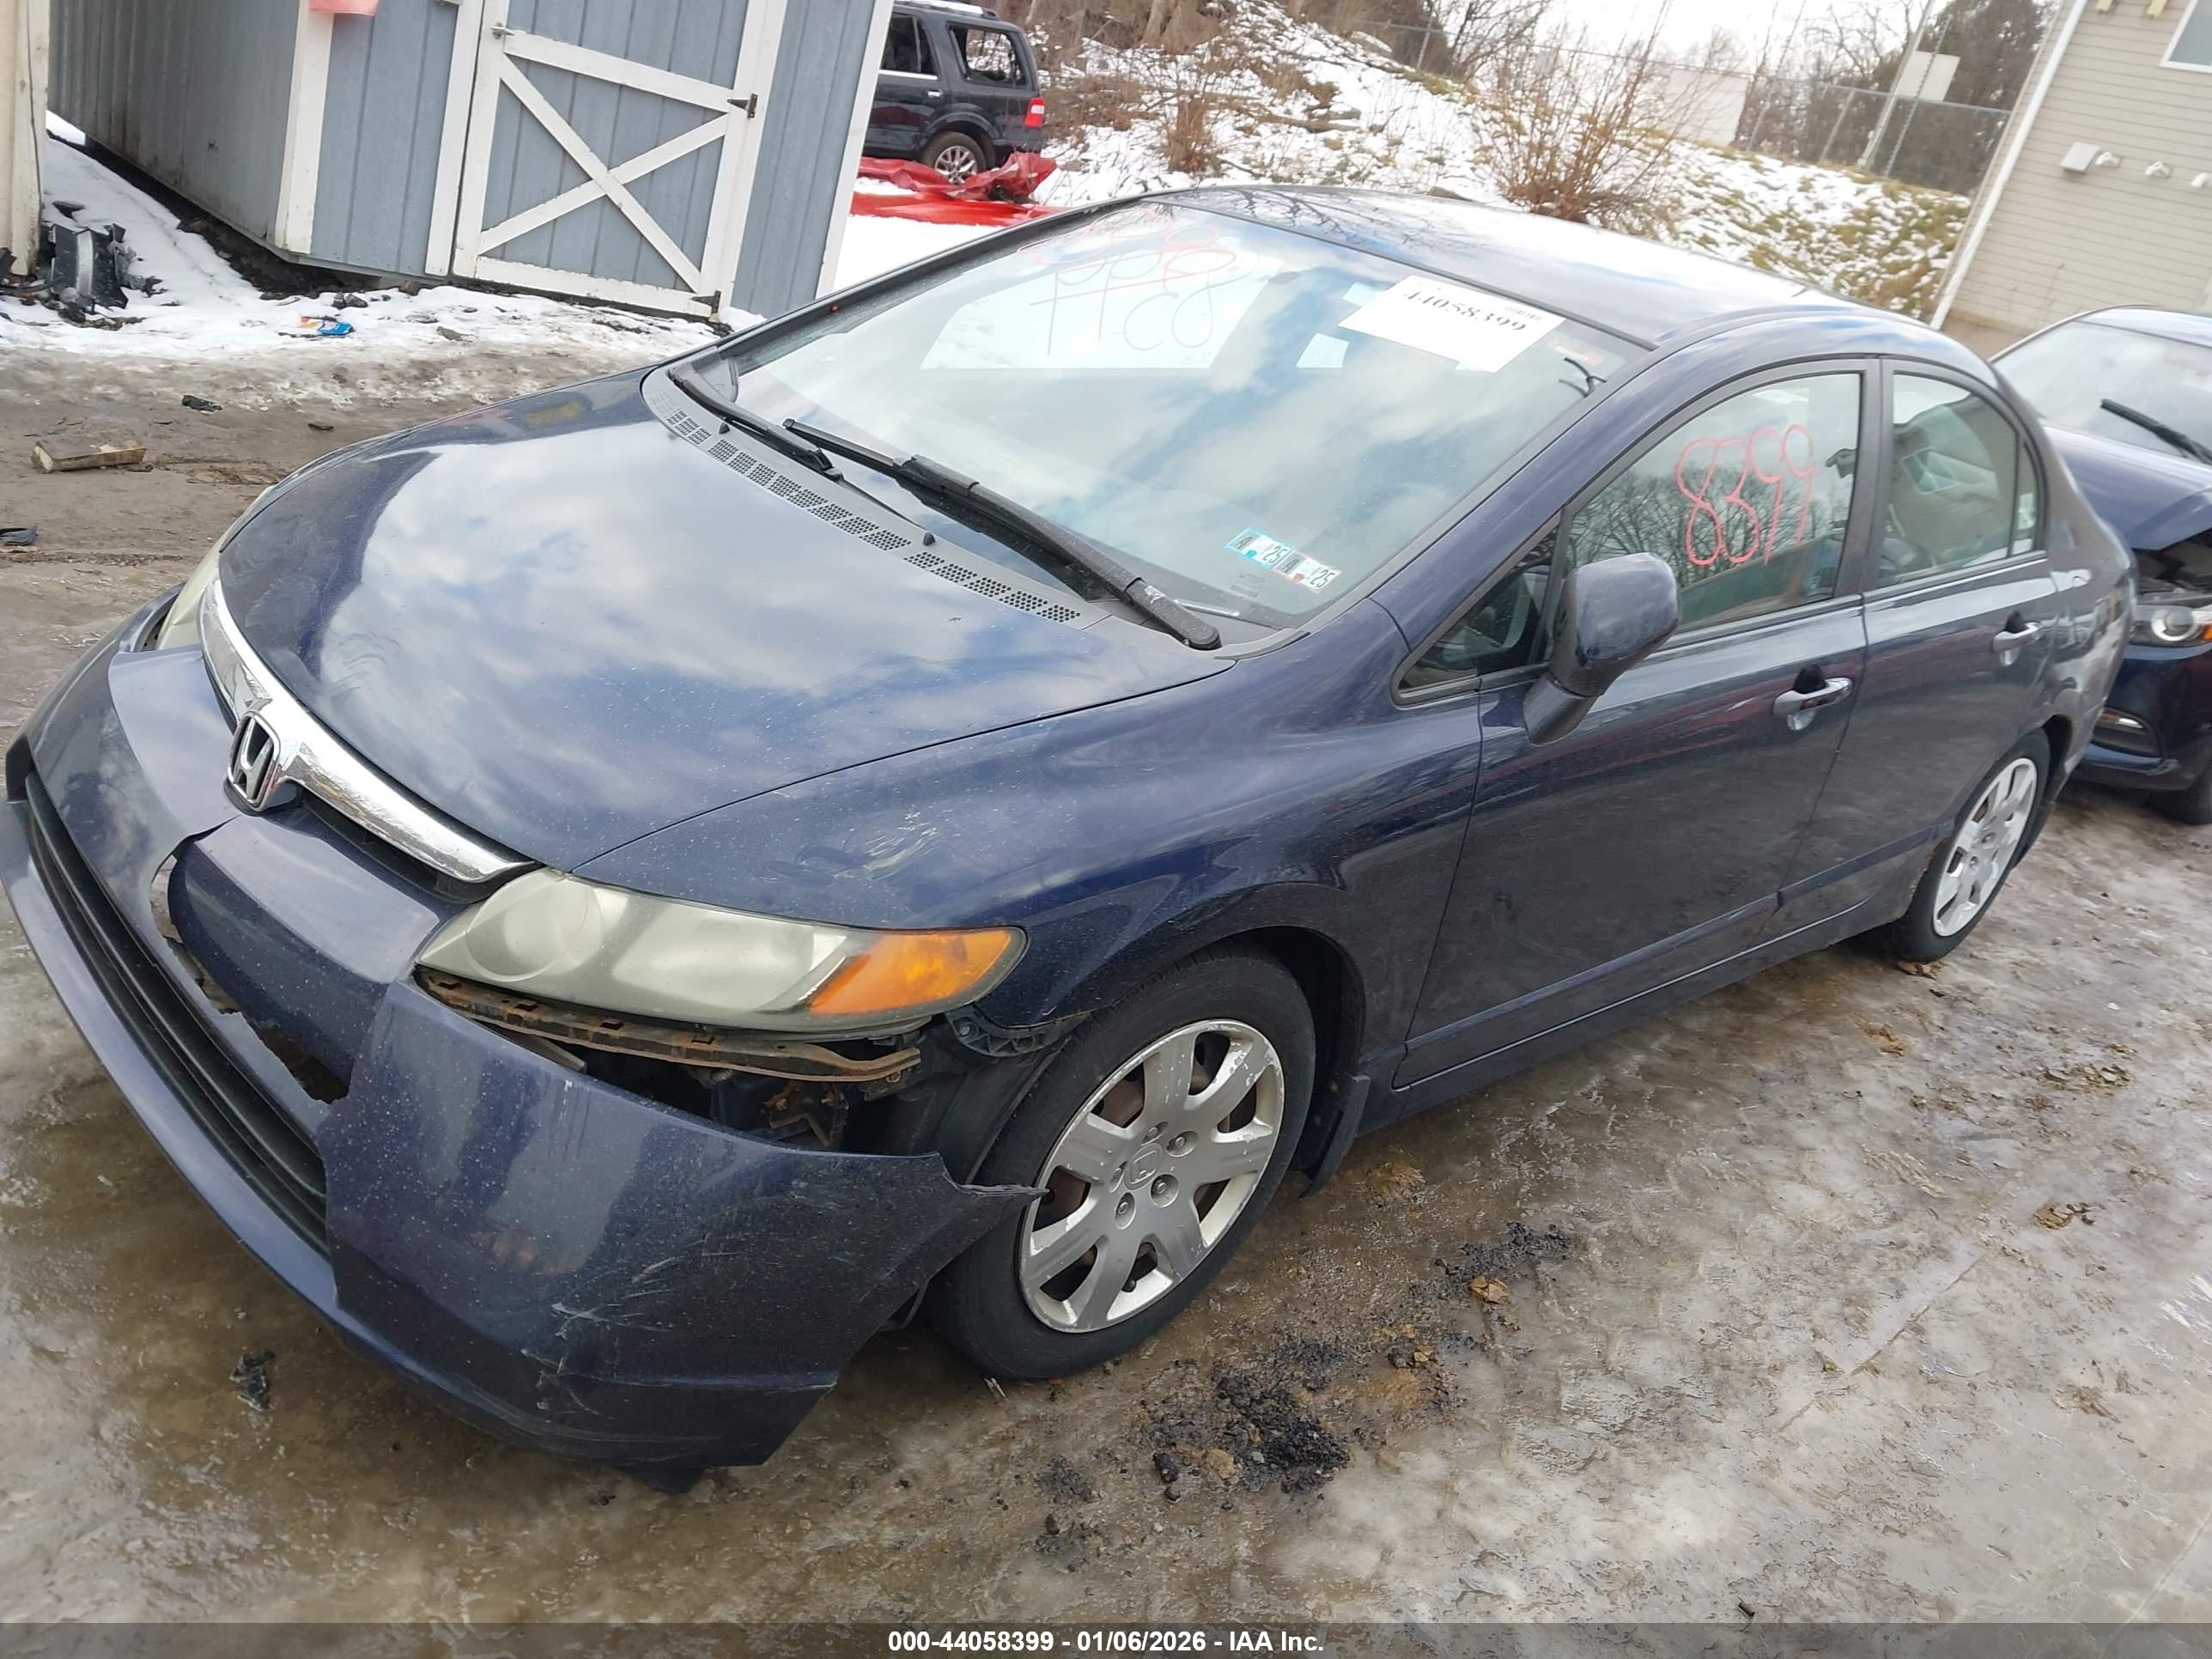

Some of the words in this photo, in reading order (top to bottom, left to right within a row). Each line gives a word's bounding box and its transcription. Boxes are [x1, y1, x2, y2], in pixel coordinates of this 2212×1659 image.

[1675, 424, 1814, 568] 8399
[1262, 545, 1288, 564] 25
[1310, 568, 1336, 589] 25
